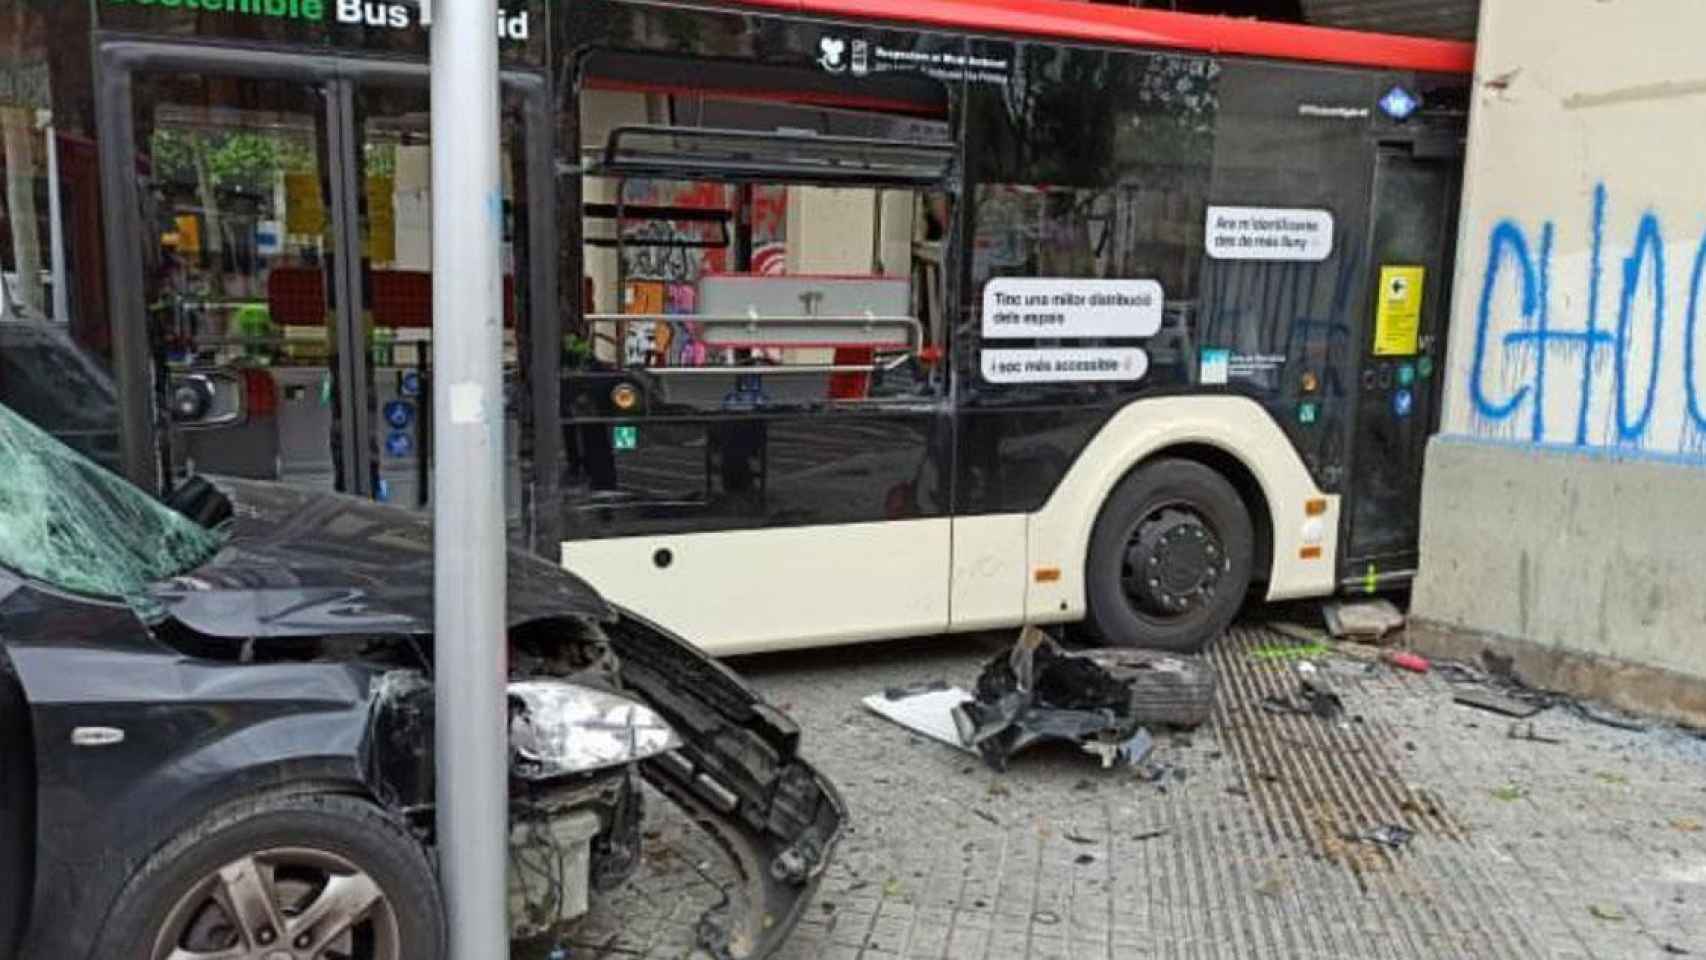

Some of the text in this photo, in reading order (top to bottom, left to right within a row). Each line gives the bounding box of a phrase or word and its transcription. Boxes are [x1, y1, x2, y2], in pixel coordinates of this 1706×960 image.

[336, 0, 410, 28] Bus
[994, 292, 1021, 306] Tinc
[1024, 294, 1049, 306] una
